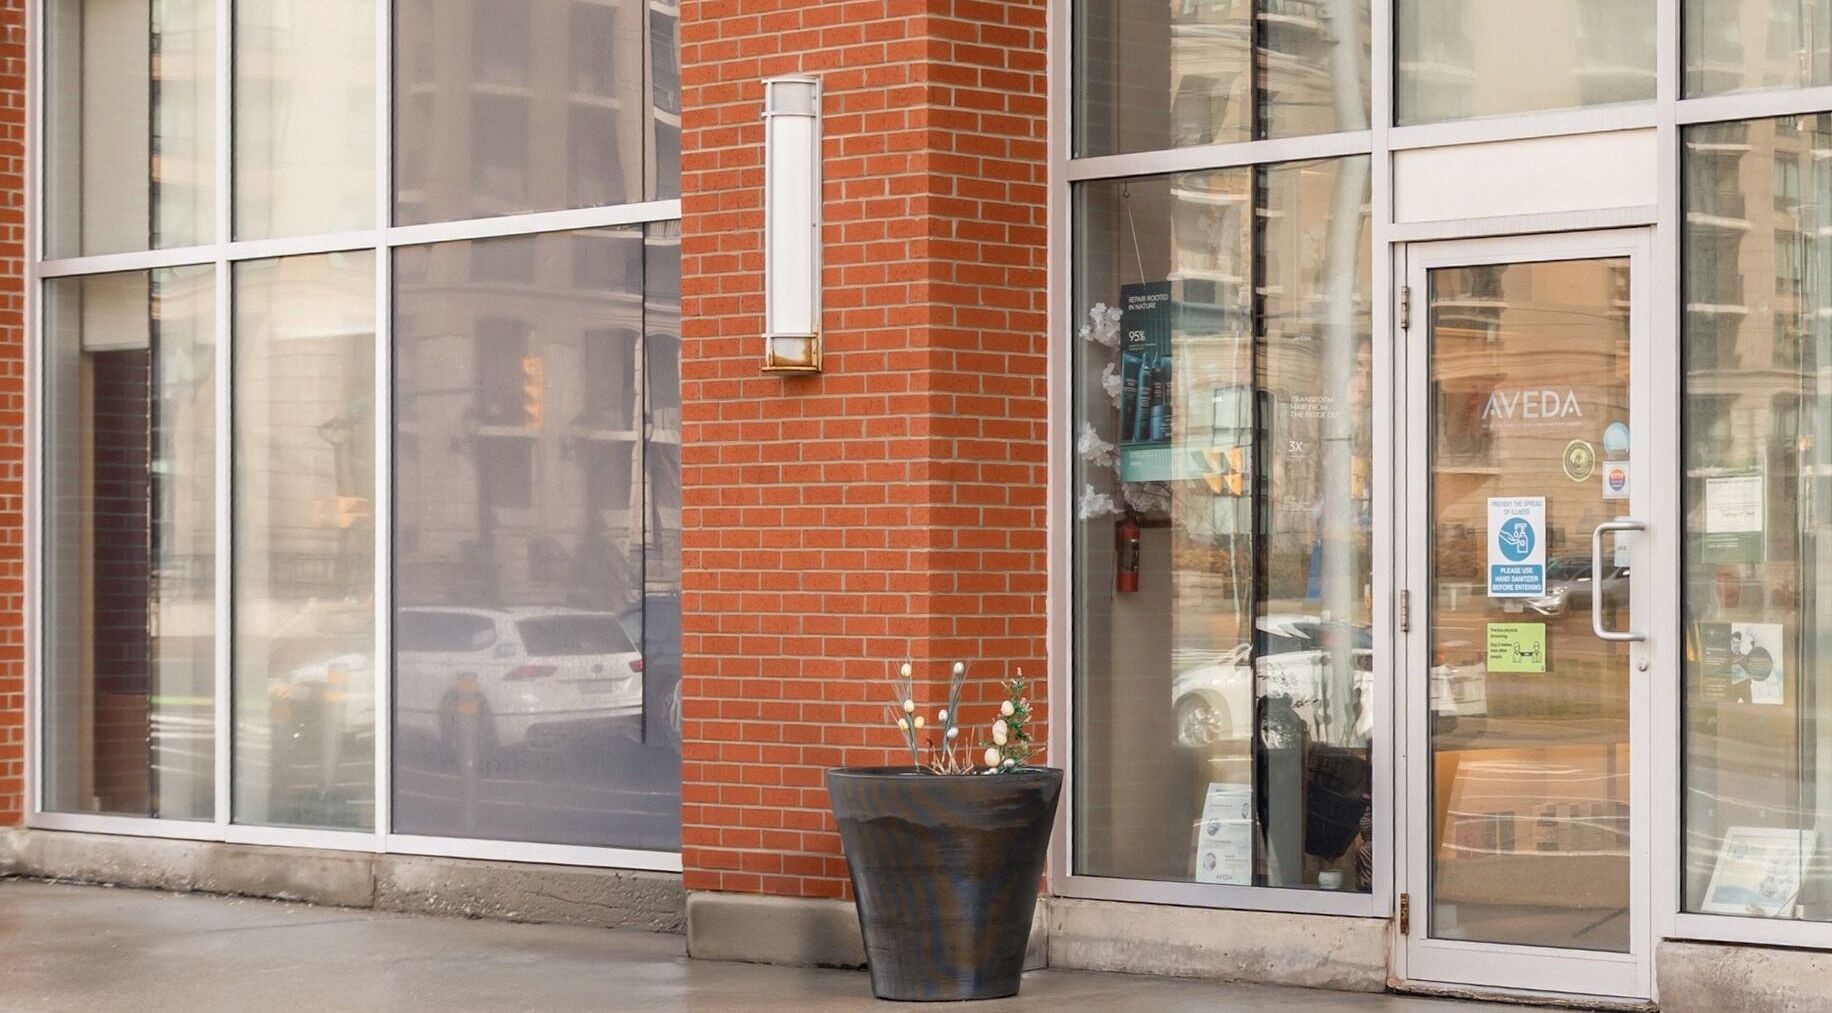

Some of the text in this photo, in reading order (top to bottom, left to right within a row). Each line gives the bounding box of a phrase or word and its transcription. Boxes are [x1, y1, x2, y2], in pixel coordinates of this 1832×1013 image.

[1135, 302, 1157, 310] NATURE
[1128, 330, 1146, 342] 95%
[1481, 389, 1583, 420] AVEDA
[1288, 440, 1303, 452] 3X
[1514, 583, 1541, 591] ENTERING
